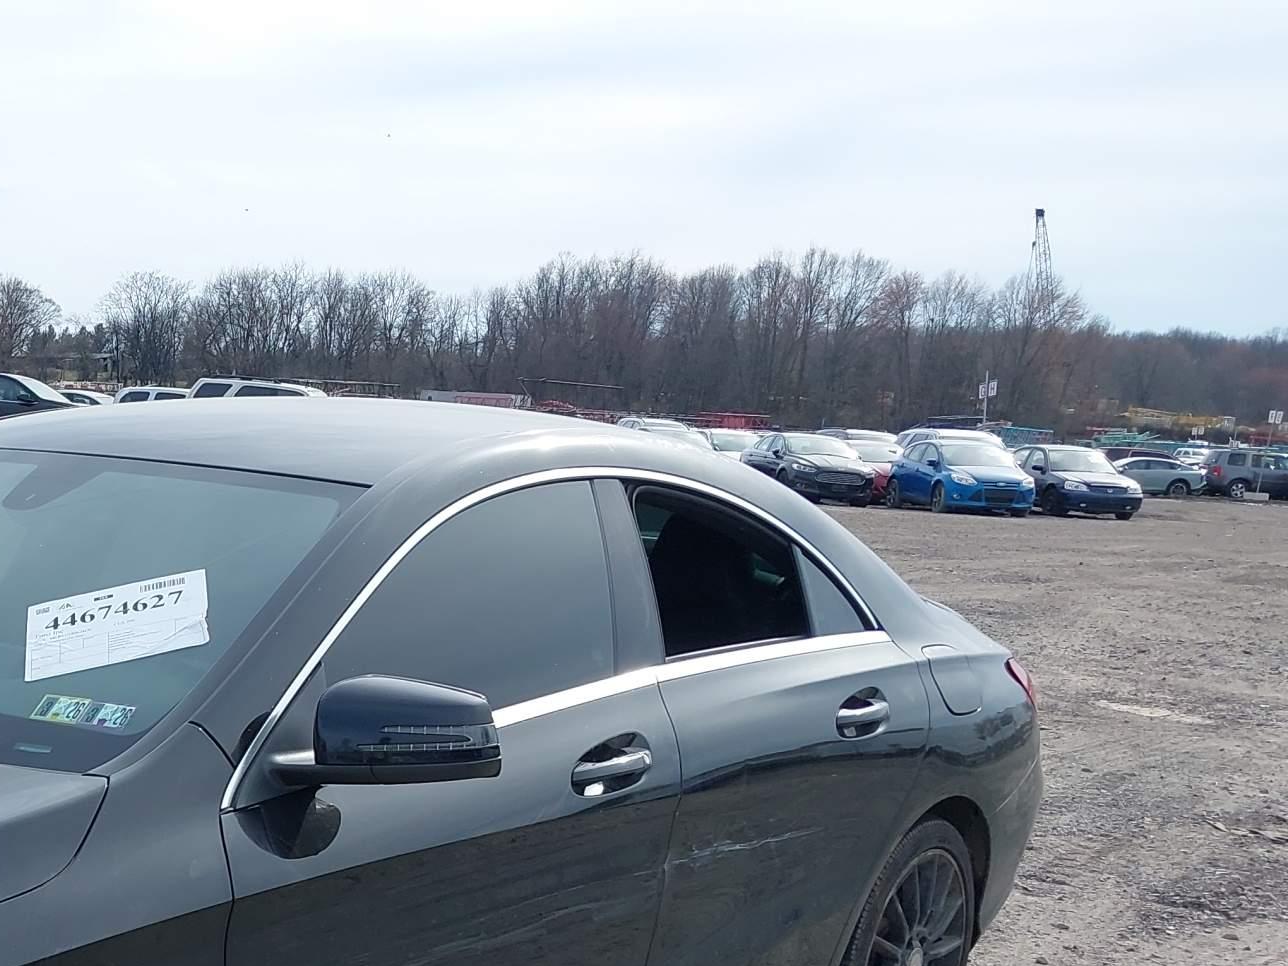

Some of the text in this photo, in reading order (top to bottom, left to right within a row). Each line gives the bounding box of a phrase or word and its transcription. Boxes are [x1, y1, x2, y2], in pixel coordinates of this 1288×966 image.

[44, 589, 184, 630] 44674627
[40, 701, 54, 717] 3
[85, 706, 99, 723] 3
